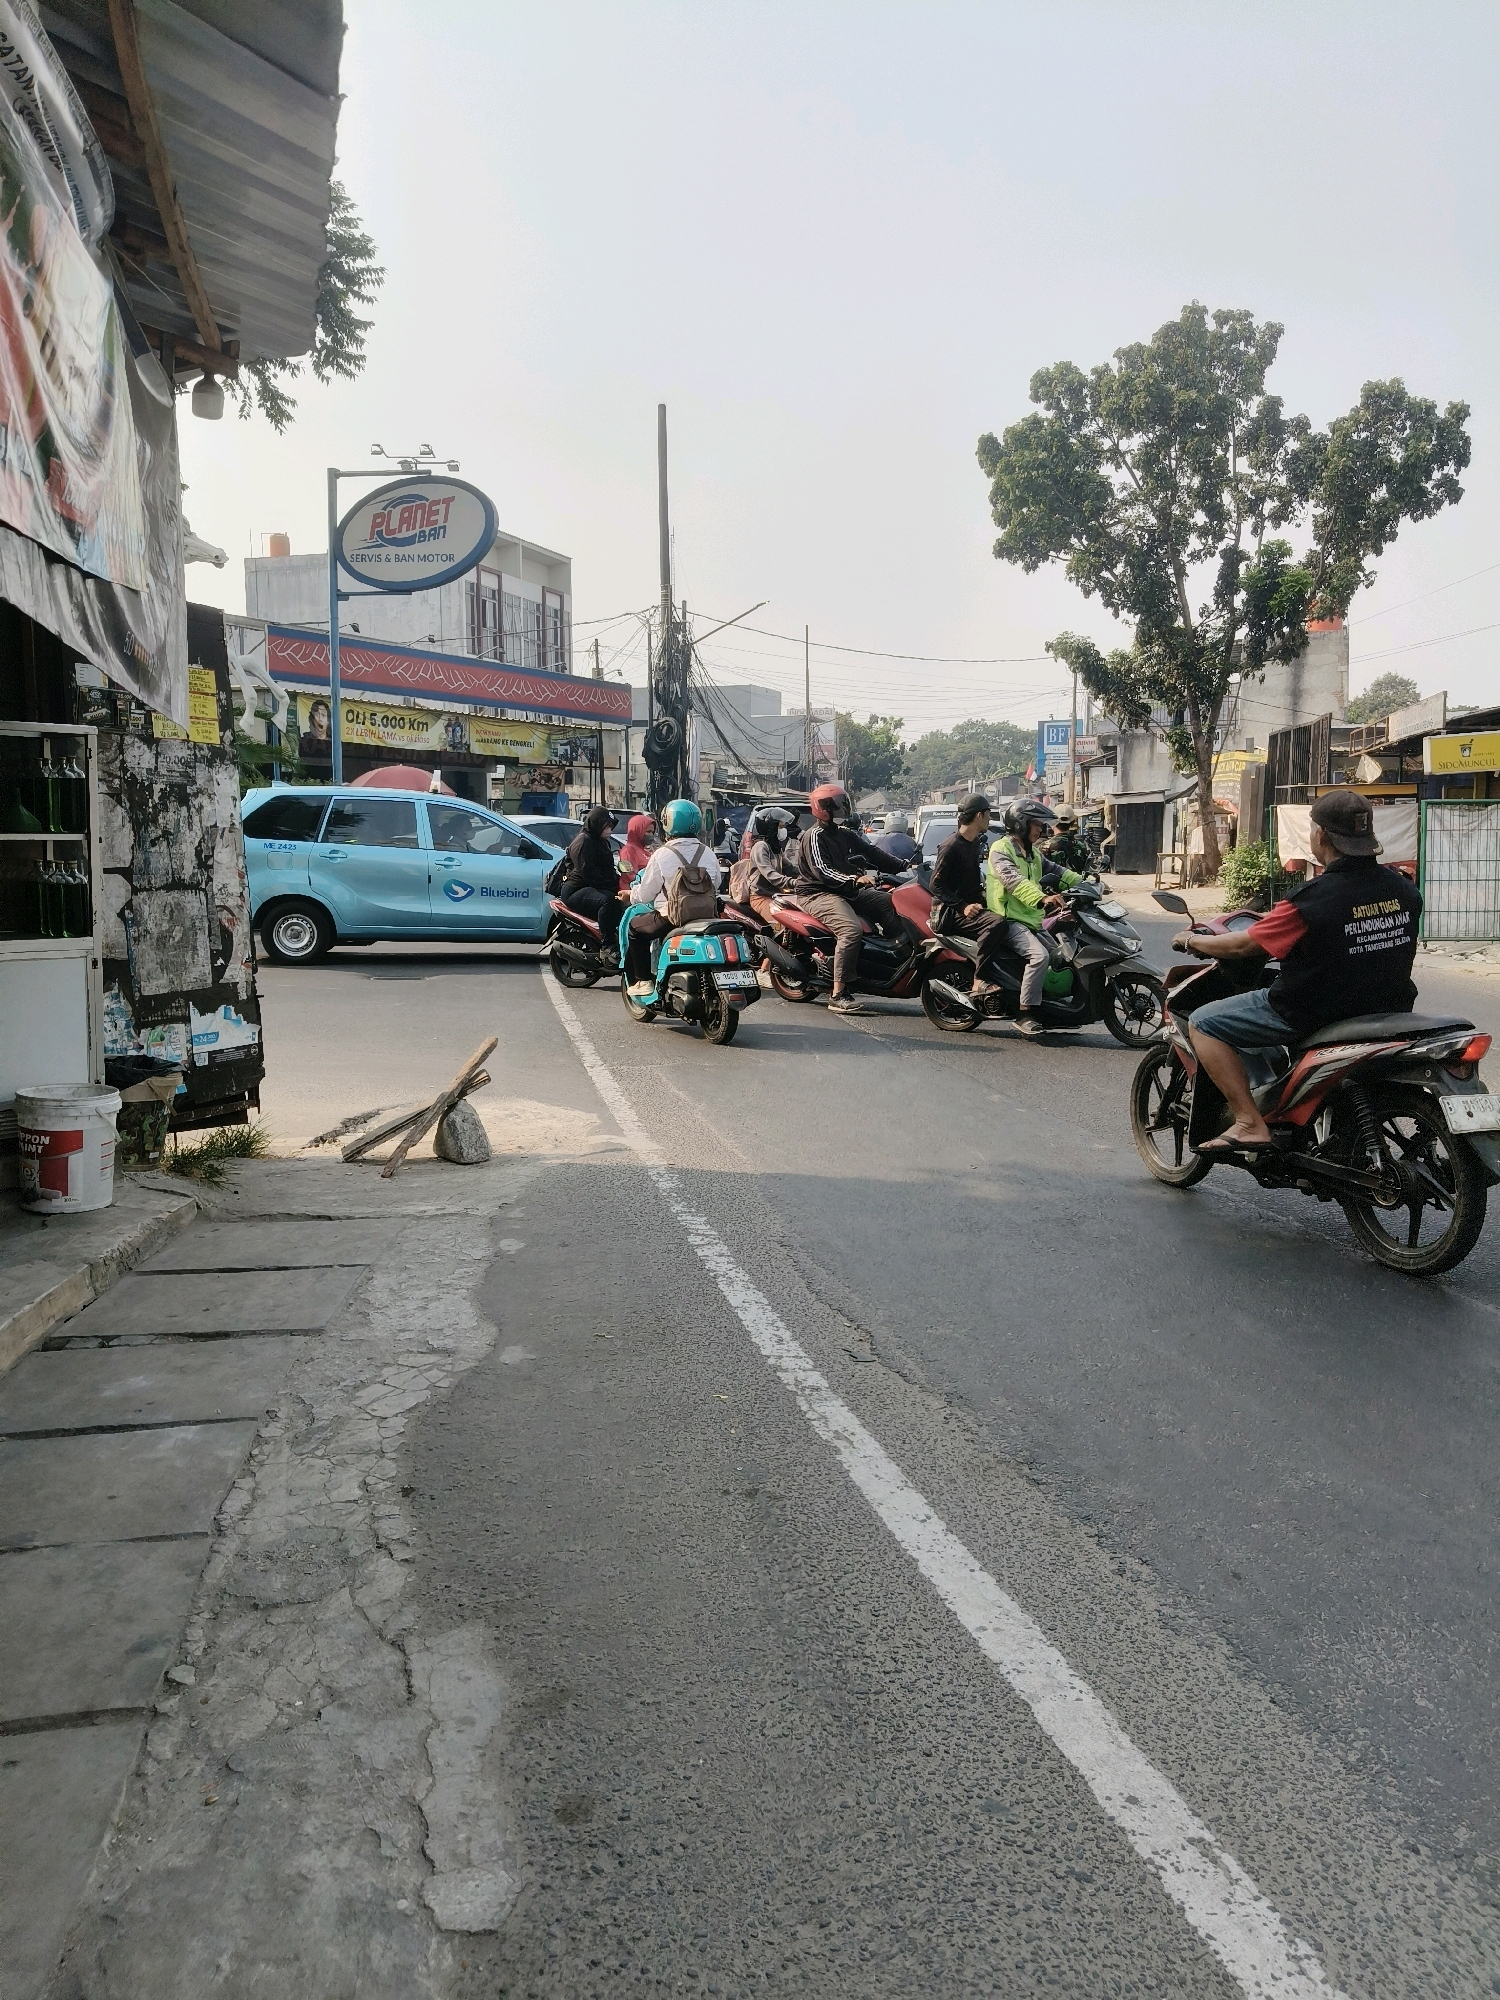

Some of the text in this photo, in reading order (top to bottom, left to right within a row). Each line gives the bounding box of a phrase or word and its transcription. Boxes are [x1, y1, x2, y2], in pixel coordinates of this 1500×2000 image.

[369, 496, 455, 540] PLANET
[417, 525, 446, 543] BAN
[350, 553, 455, 563] SERVIS & BAN MOTOR
[345, 709, 366, 725] OLI
[369, 713, 406, 730] 5.000
[345, 727, 355, 736] 2X
[355, 728, 377, 739] LEBIH
[377, 730, 398, 742] LAMA
[480, 886, 530, 899] Bluebird
[1352, 899, 1400, 918] SATUAN TUGAS
[1344, 915, 1395, 936] PERLINDUNGAN
